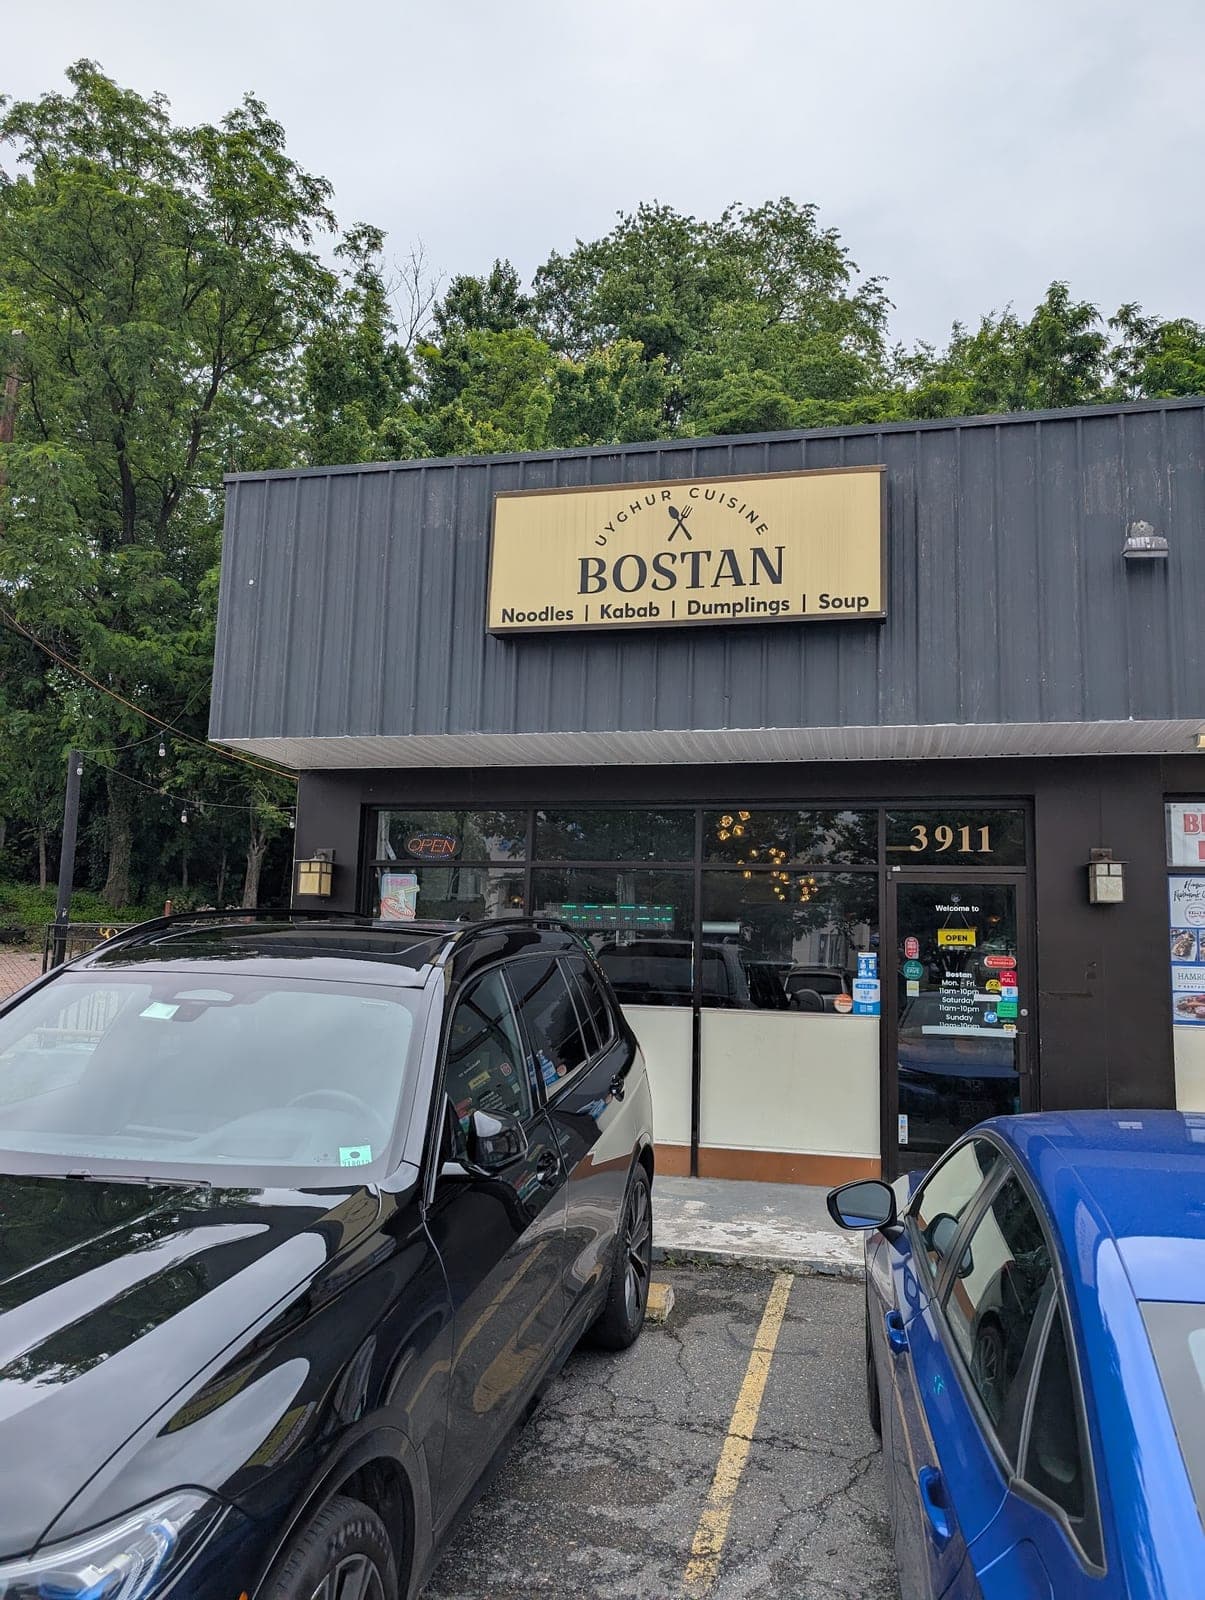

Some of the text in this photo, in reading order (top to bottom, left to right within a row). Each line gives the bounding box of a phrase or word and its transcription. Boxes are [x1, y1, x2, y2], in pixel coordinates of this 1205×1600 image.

[595, 487, 769, 548] UYGHUR CUISINE
[577, 546, 786, 595] BOSTAN
[501, 606, 574, 624] Noodles
[600, 601, 660, 620] Kabab
[687, 597, 790, 618] Dumplings
[818, 594, 870, 613] Soup
[910, 824, 993, 853] 3911
[407, 838, 457, 854] OPEN
[935, 904, 969, 912] Welcome
[945, 934, 968, 942] OPEN
[942, 997, 975, 1005] Saturday
[939, 1005, 980, 1013] 11am-10pm
[945, 1014, 973, 1023] Sunday
